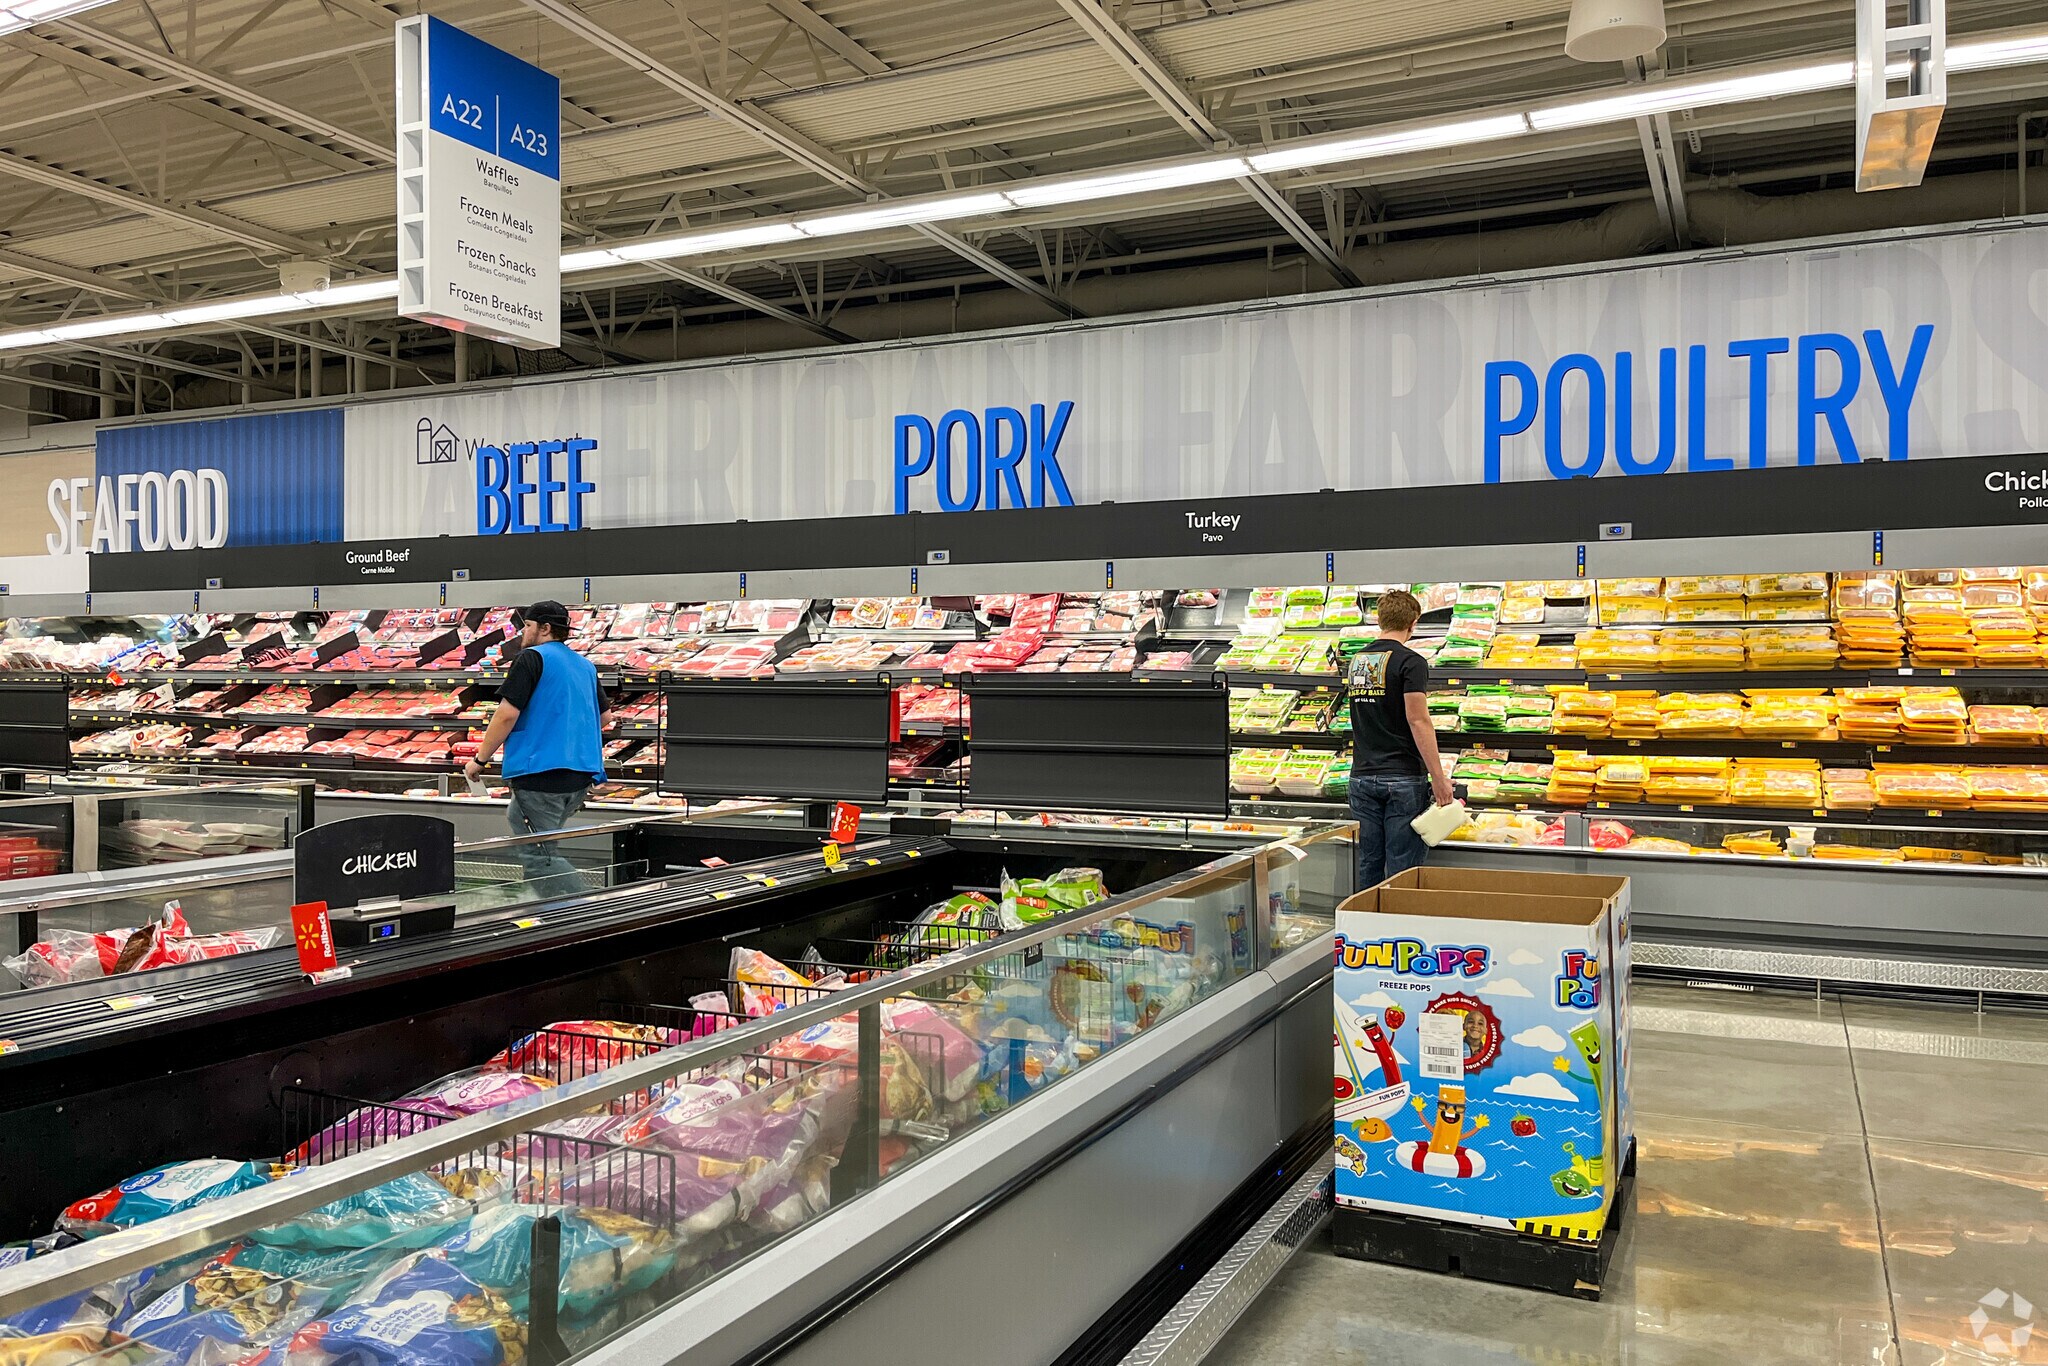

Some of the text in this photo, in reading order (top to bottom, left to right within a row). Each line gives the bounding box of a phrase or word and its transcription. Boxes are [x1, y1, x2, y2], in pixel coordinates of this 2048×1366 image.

[441, 93, 482, 130] A22
[510, 123, 548, 157] A23
[476, 158, 519, 187] Waffles
[483, 178, 513, 196] Barquillos
[460, 196, 534, 235] Frozen Meals
[466, 216, 528, 243] Comidas Congeladas
[457, 239, 537, 278] Frozen Snacks
[468, 260, 527, 285] Botanas Congeladas
[449, 282, 544, 322] Frozen Breakfast
[463, 304, 531, 329] Desayunos Congelados
[1483, 324, 1935, 484] POULTRY
[894, 400, 1077, 515] PORK
[477, 439, 598, 536] BEEF
[46, 468, 229, 556] SEAFOOD
[1185, 511, 1241, 531] Turkey
[1202, 533, 1224, 542] Pavo
[345, 549, 410, 564] Ground Beef
[377, 566, 395, 574] Molida
[341, 850, 417, 876] CHICKEN
[317, 911, 332, 958] Rollback
[1379, 981, 1431, 992] FREEZE POPS
[1378, 1089, 1405, 1101] FUN POPS
[78, 1201, 98, 1214] 3
